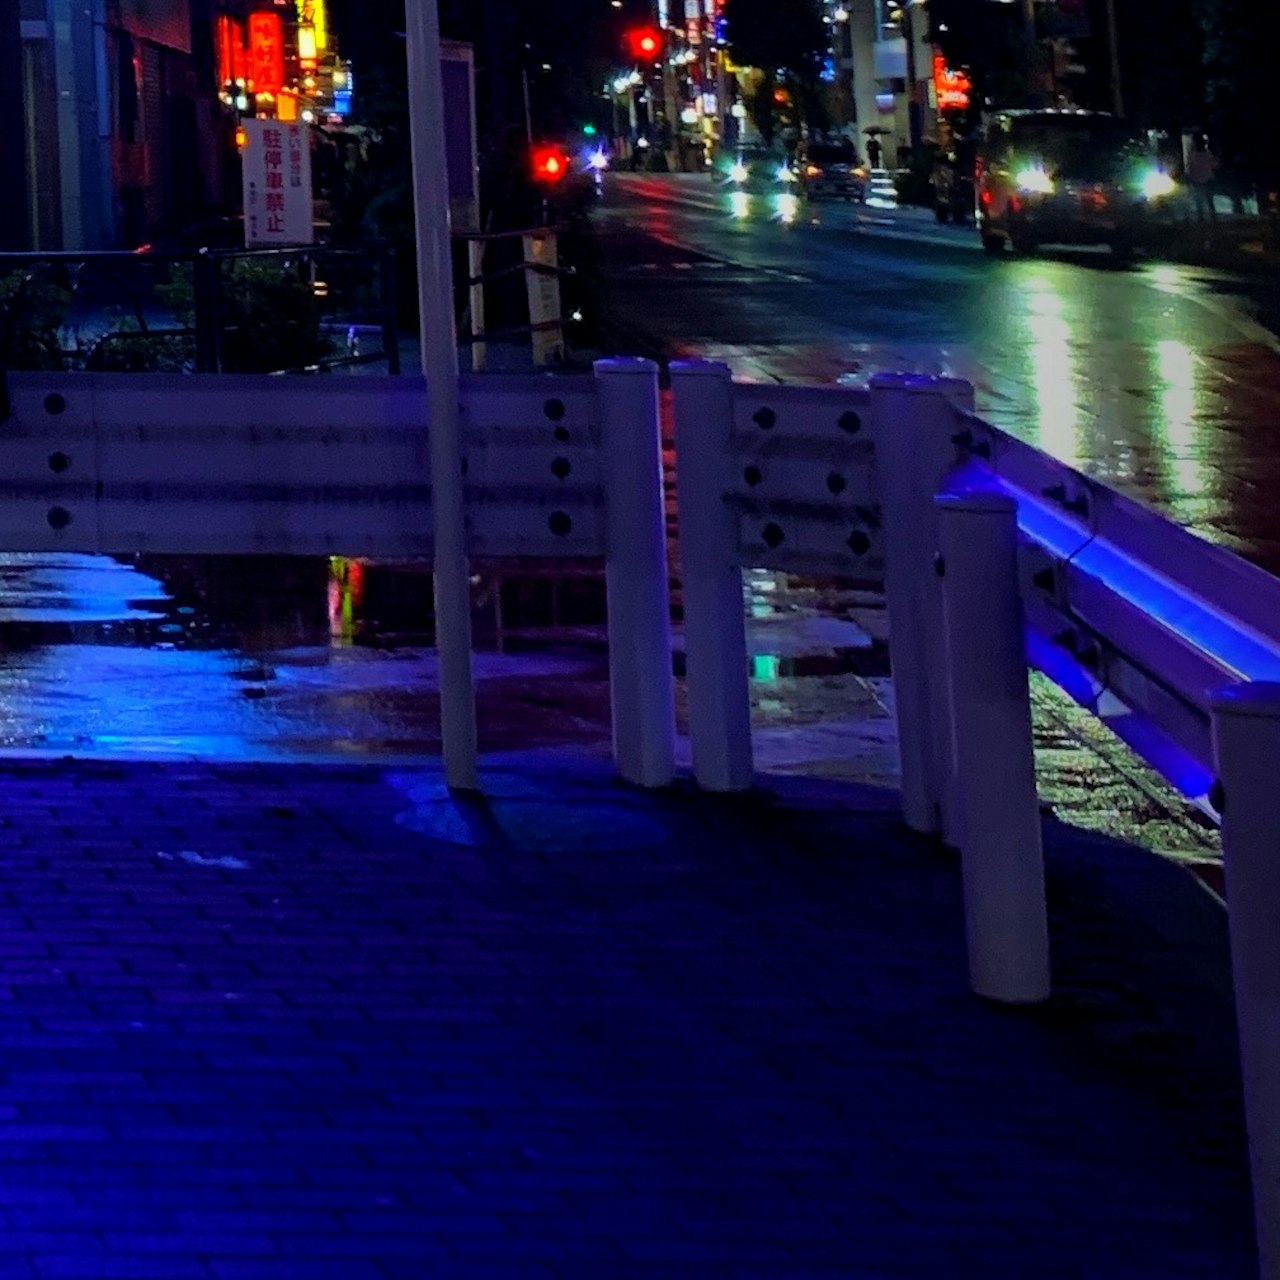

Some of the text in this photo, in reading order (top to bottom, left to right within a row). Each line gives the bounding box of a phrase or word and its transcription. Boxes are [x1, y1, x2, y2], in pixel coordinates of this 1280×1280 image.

[263, 129, 285, 232] 駐停車禁止
